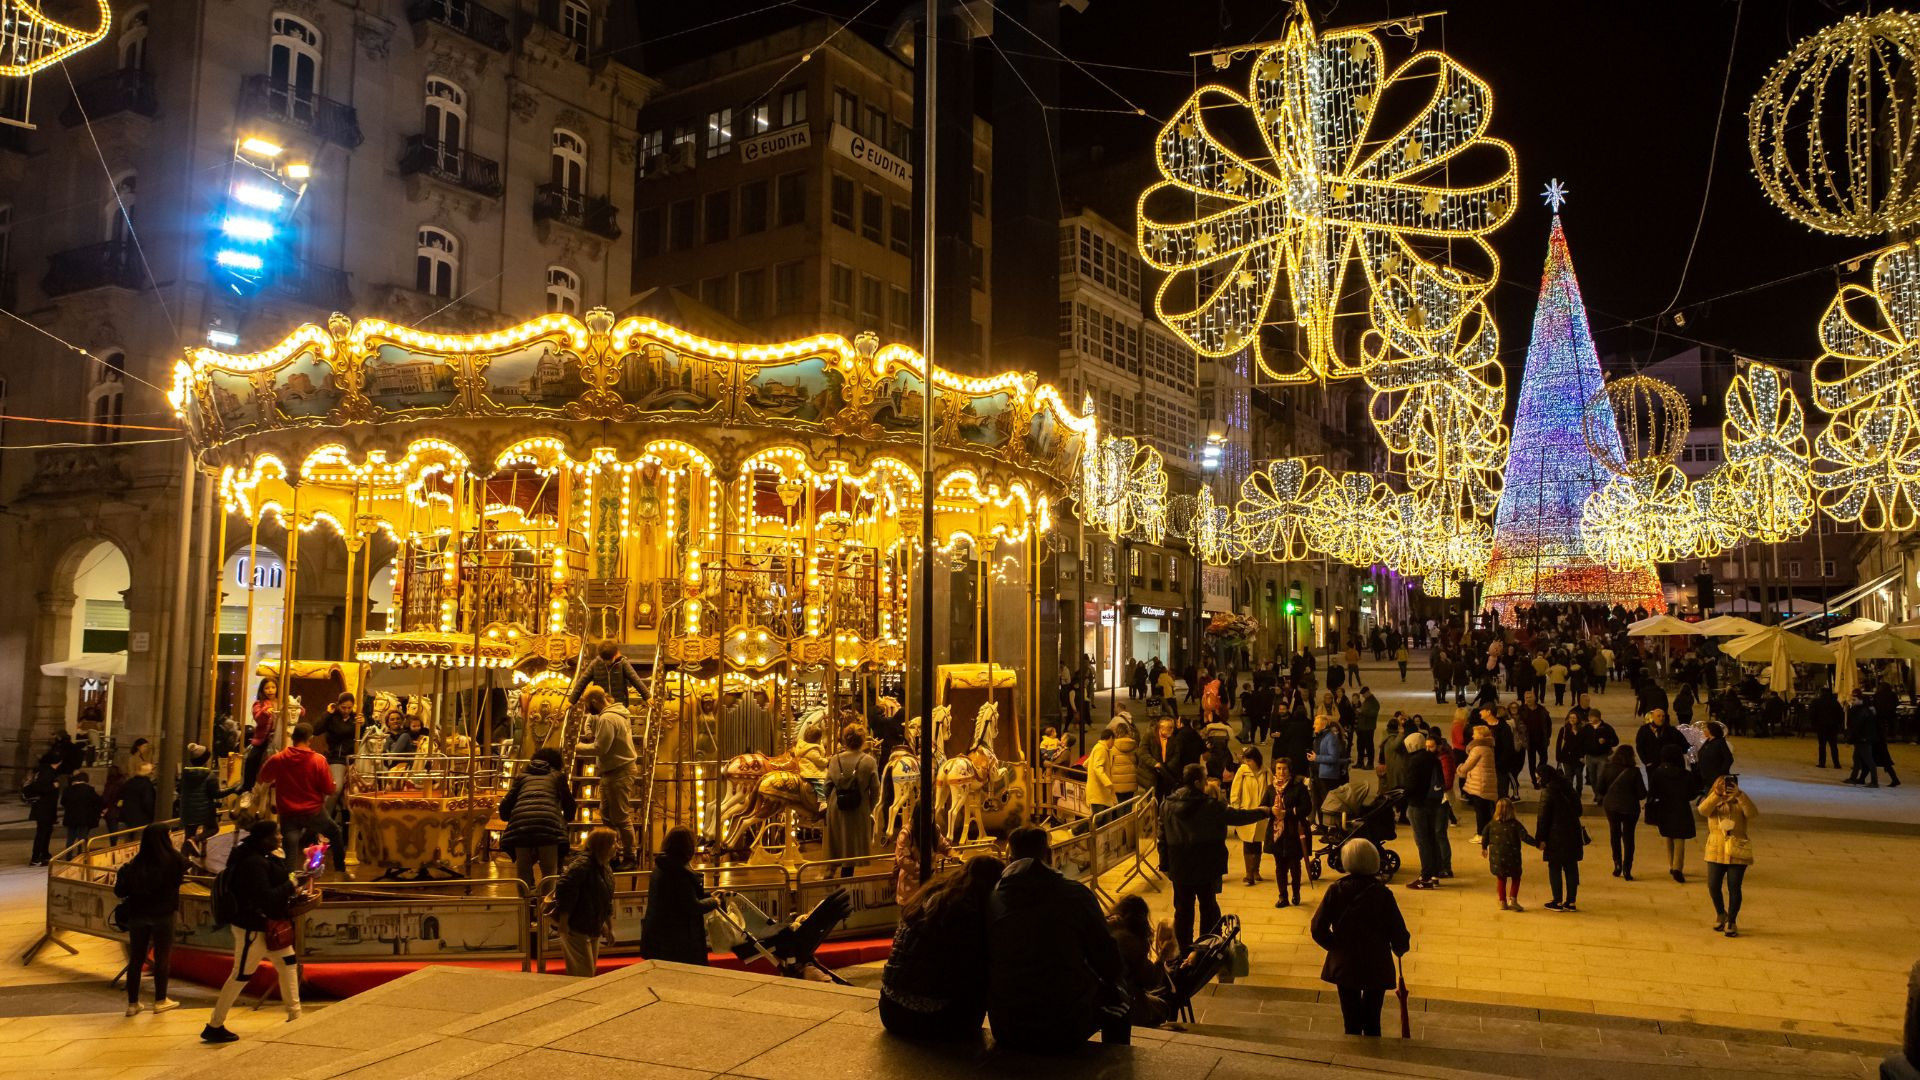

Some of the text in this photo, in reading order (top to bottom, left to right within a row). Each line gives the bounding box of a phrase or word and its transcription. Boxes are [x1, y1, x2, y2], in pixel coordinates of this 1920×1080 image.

[761, 132, 806, 154] EUDITA
[868, 148, 906, 180] EUDITA
[1148, 606, 1166, 617] Computer
